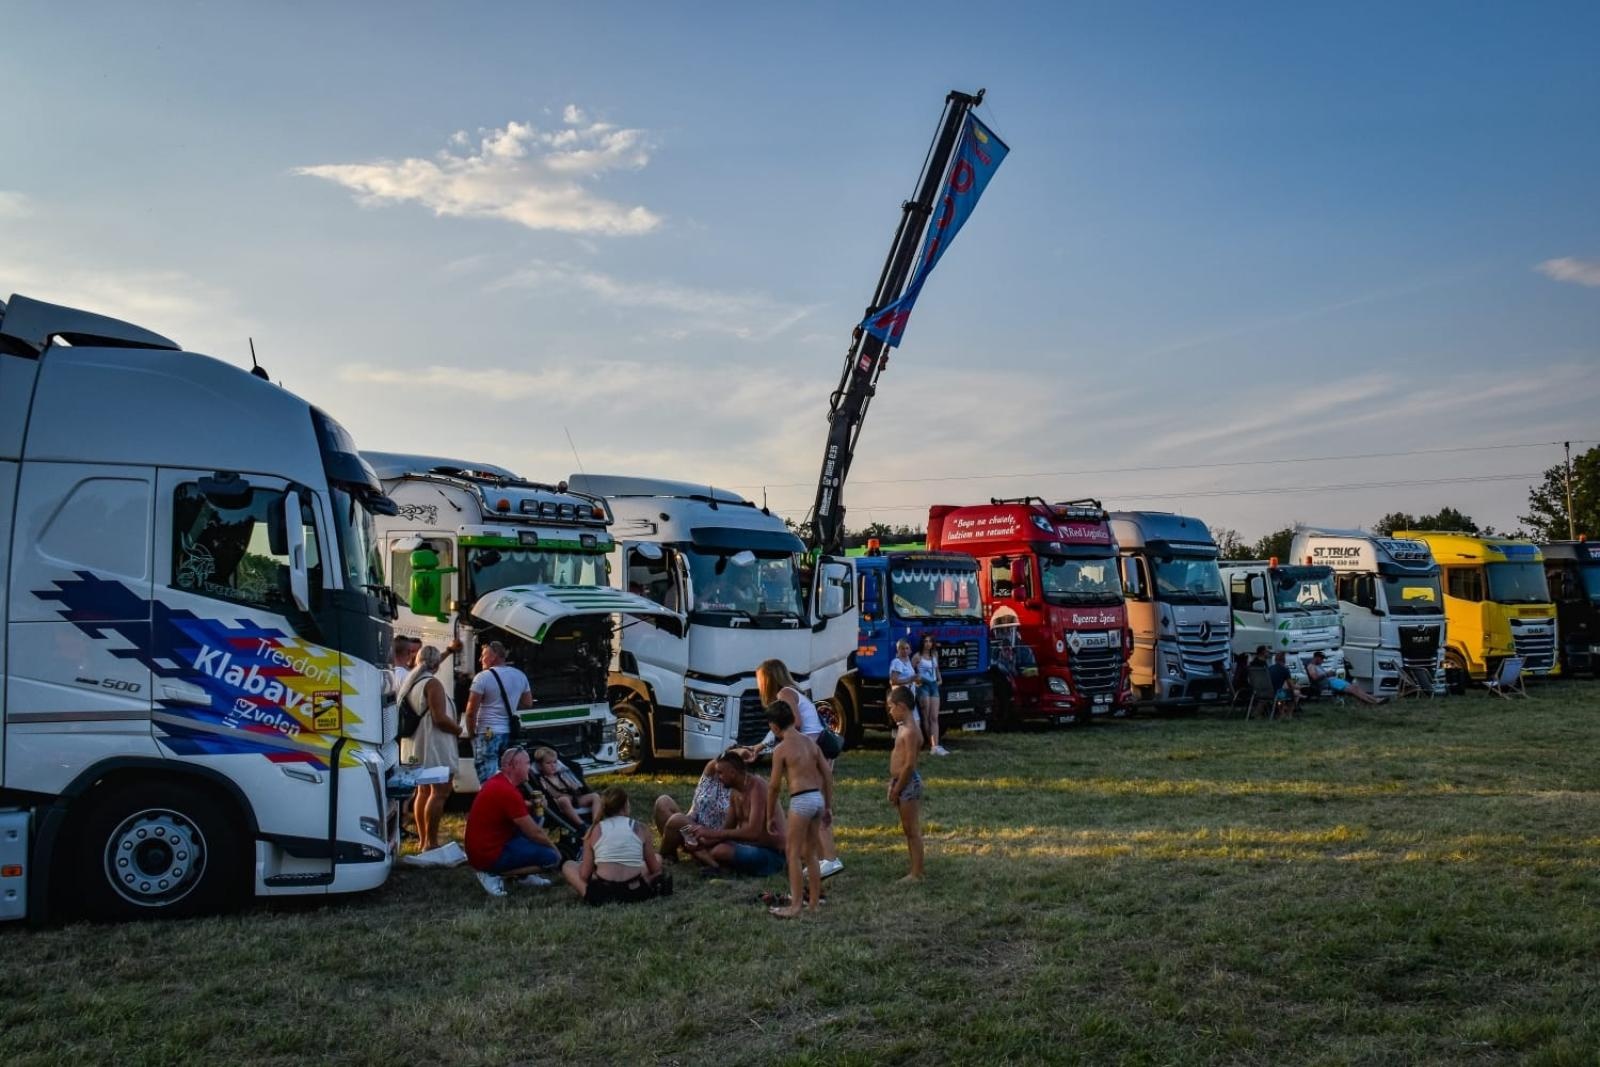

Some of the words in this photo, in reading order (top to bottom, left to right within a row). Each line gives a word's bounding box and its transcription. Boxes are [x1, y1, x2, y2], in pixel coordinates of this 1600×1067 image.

[1067, 527, 1082, 537] Red
[1313, 547, 1325, 556] ST
[1327, 547, 1360, 557] TRUCK
[1086, 638, 1107, 646] DAF
[941, 648, 966, 657] MAN
[256, 637, 335, 685] Tresdorf
[101, 678, 141, 693] 500
[192, 644, 314, 718] Klabava
[242, 702, 301, 738] Zvolen
